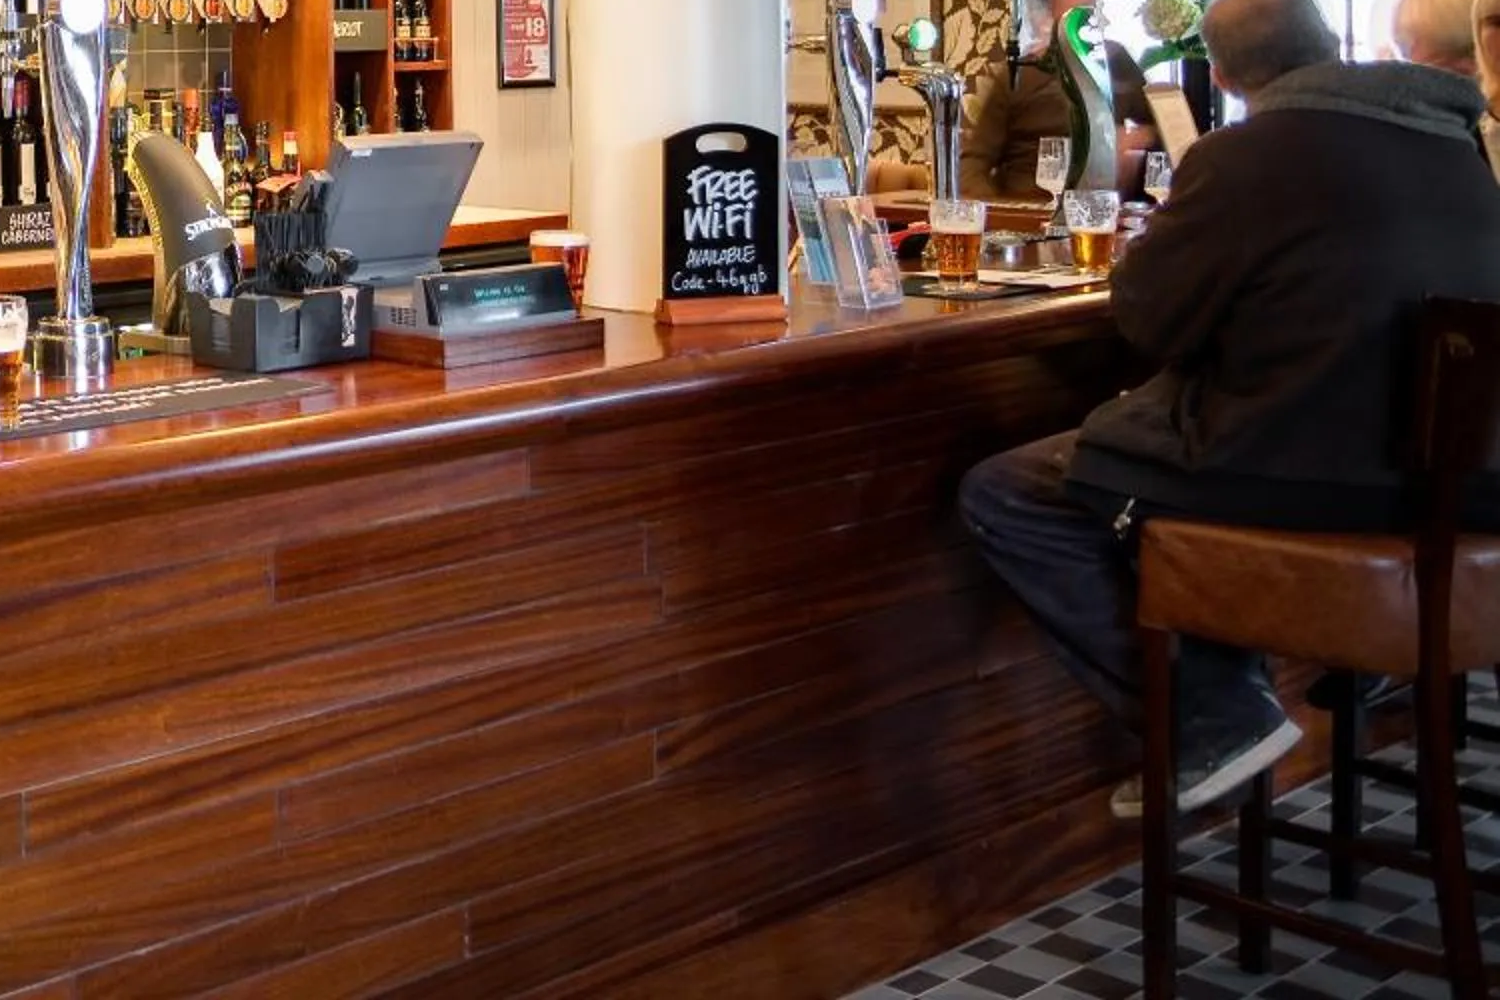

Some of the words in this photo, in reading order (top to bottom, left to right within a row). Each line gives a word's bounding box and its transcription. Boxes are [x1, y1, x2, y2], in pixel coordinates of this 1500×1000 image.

[687, 165, 759, 205] FREE
[1, 228, 55, 246] CABERNE
[685, 244, 756, 269] AVAILABLE
[671, 271, 706, 291] Code
